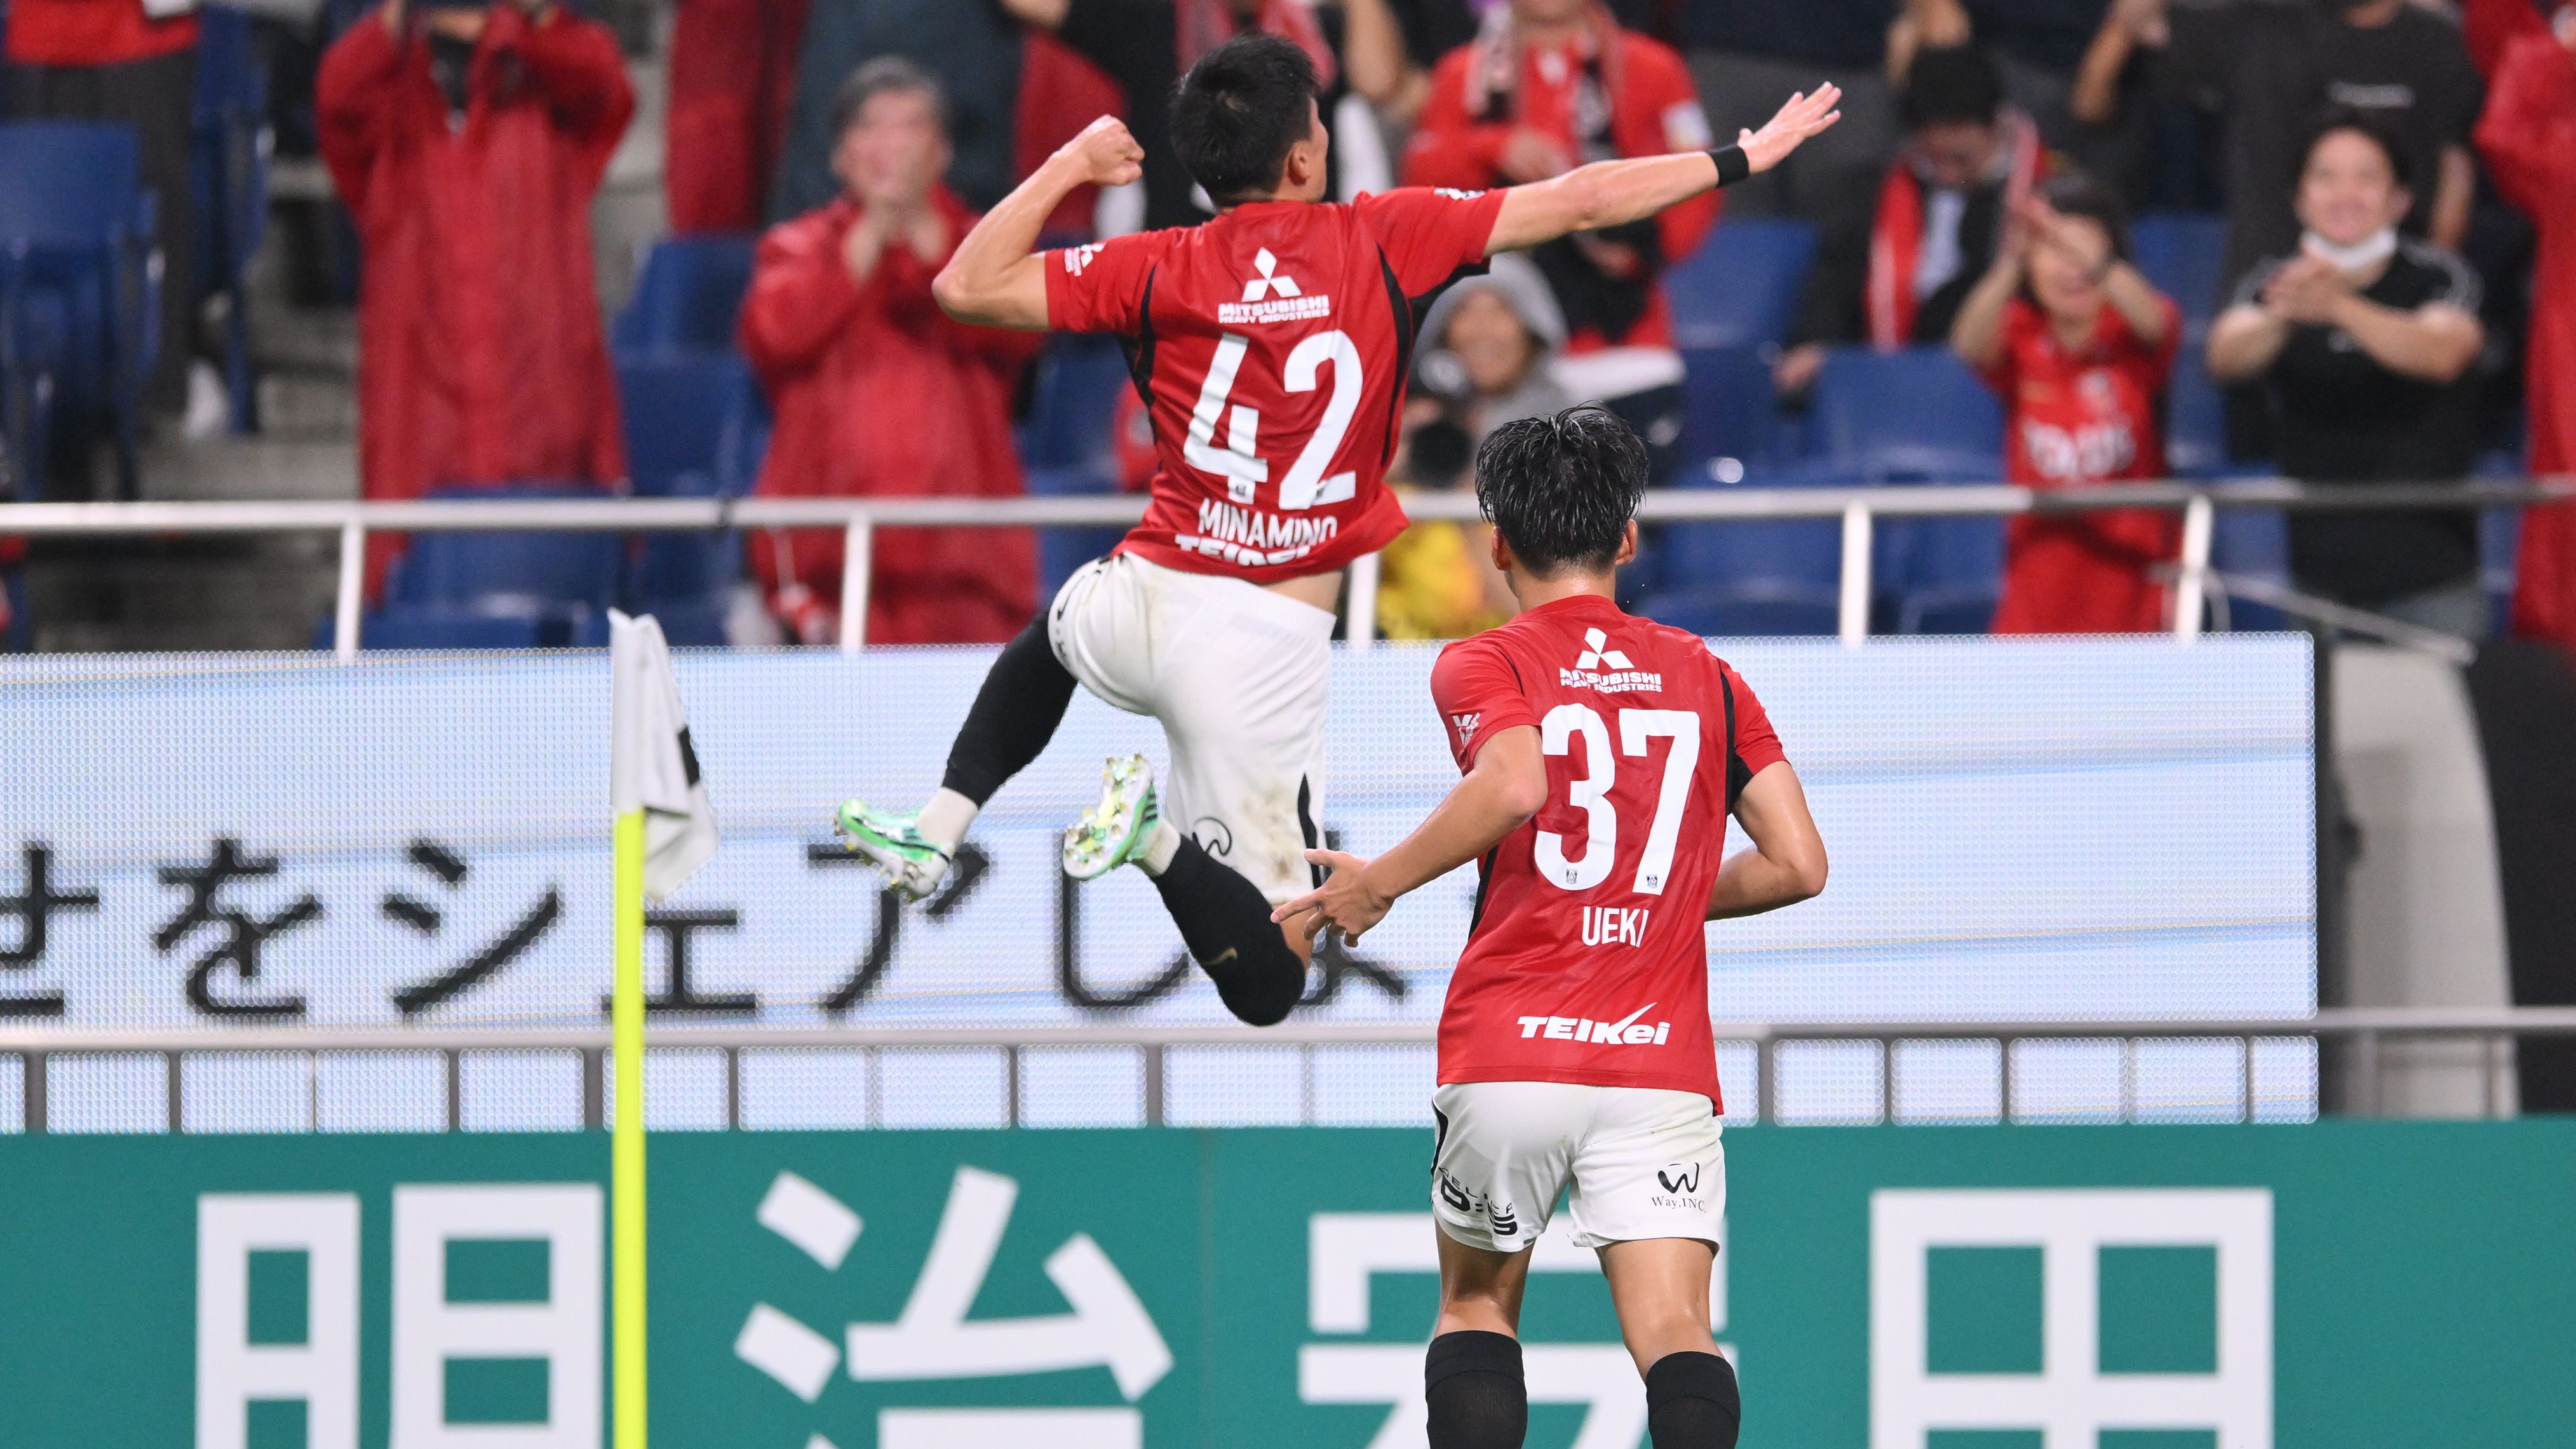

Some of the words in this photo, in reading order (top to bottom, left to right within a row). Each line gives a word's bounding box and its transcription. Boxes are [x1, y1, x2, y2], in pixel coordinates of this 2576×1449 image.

[1218, 295, 1330, 317] MITSUBISHI
[1218, 315, 1257, 324] HEAVY
[1258, 307, 1330, 324] INDUSTRIES
[1183, 329, 1363, 510] 42
[1197, 497, 1338, 549] MINAMINO
[1560, 667, 1662, 687] MITSUBISHI
[1594, 683, 1662, 694] INDUSTRIES
[1534, 703, 1701, 896] 37
[1582, 906, 1650, 948] UEKI
